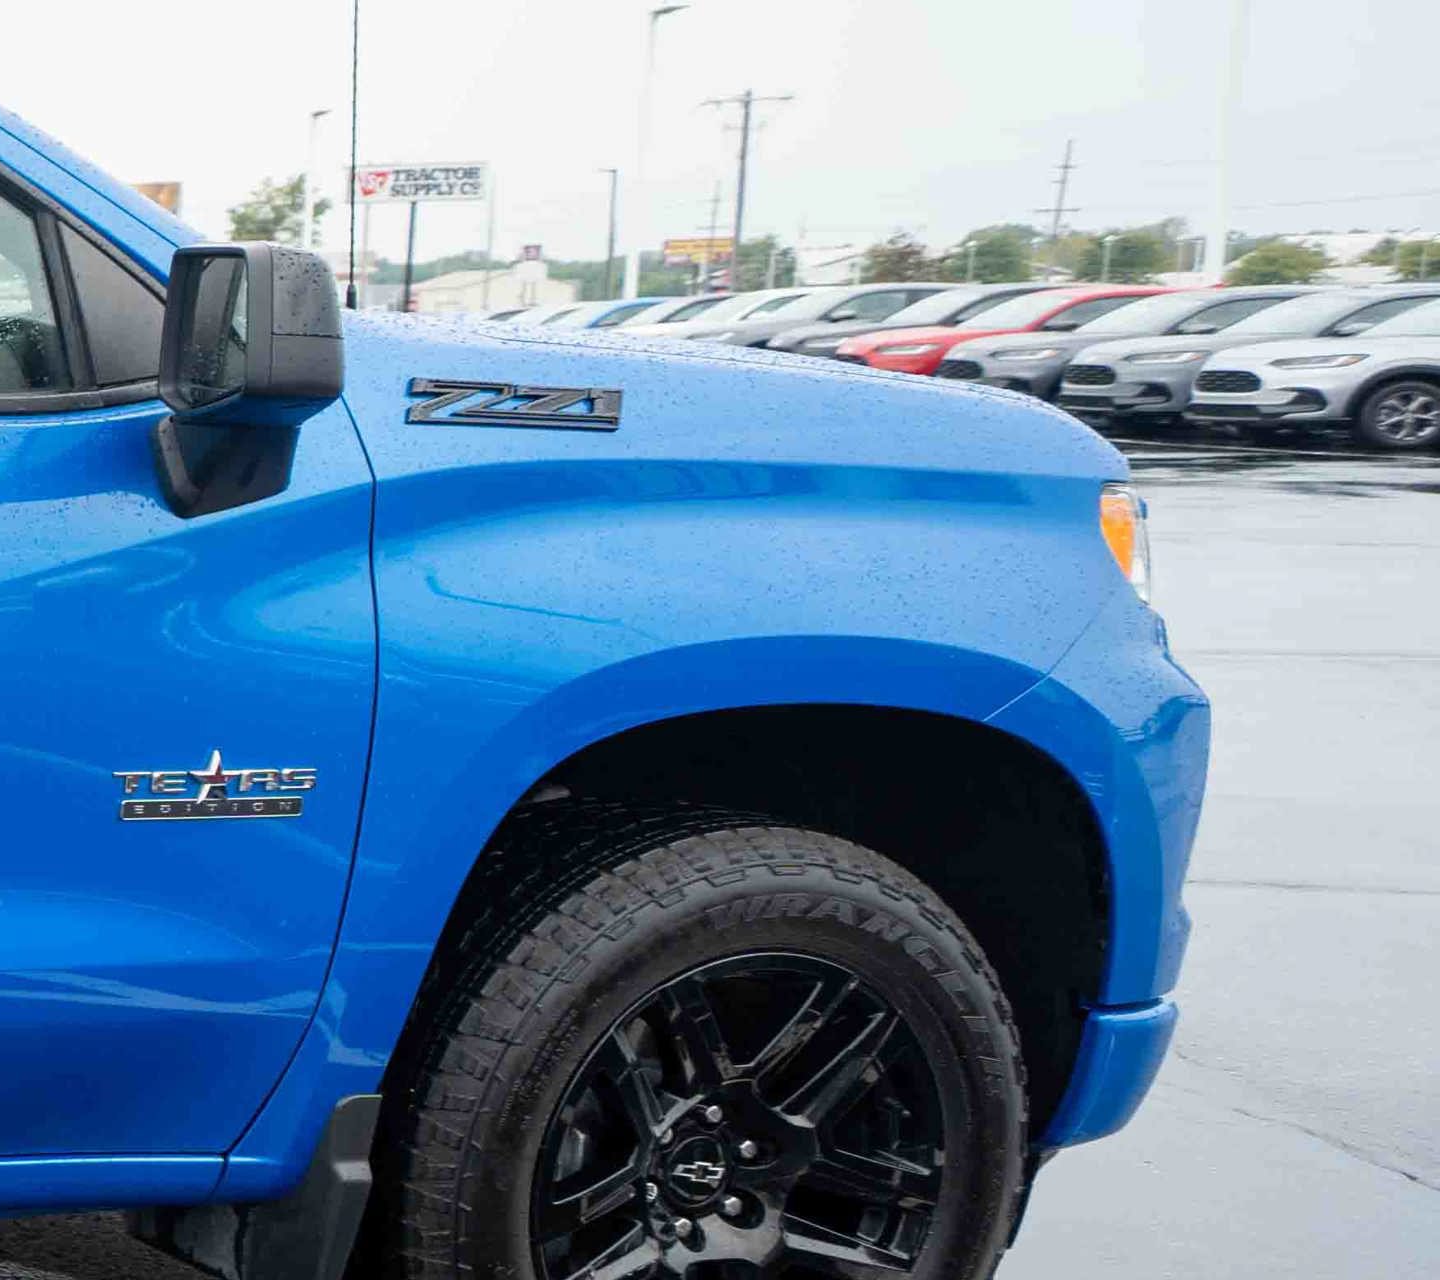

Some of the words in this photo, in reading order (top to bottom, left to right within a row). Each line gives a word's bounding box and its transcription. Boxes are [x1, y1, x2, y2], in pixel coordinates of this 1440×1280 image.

[391, 167, 480, 182] TRACTOR
[391, 182, 453, 197] SUPPLY
[405, 377, 623, 432] Z71
[112, 754, 317, 800] TEXAS
[133, 800, 293, 815] EDITION
